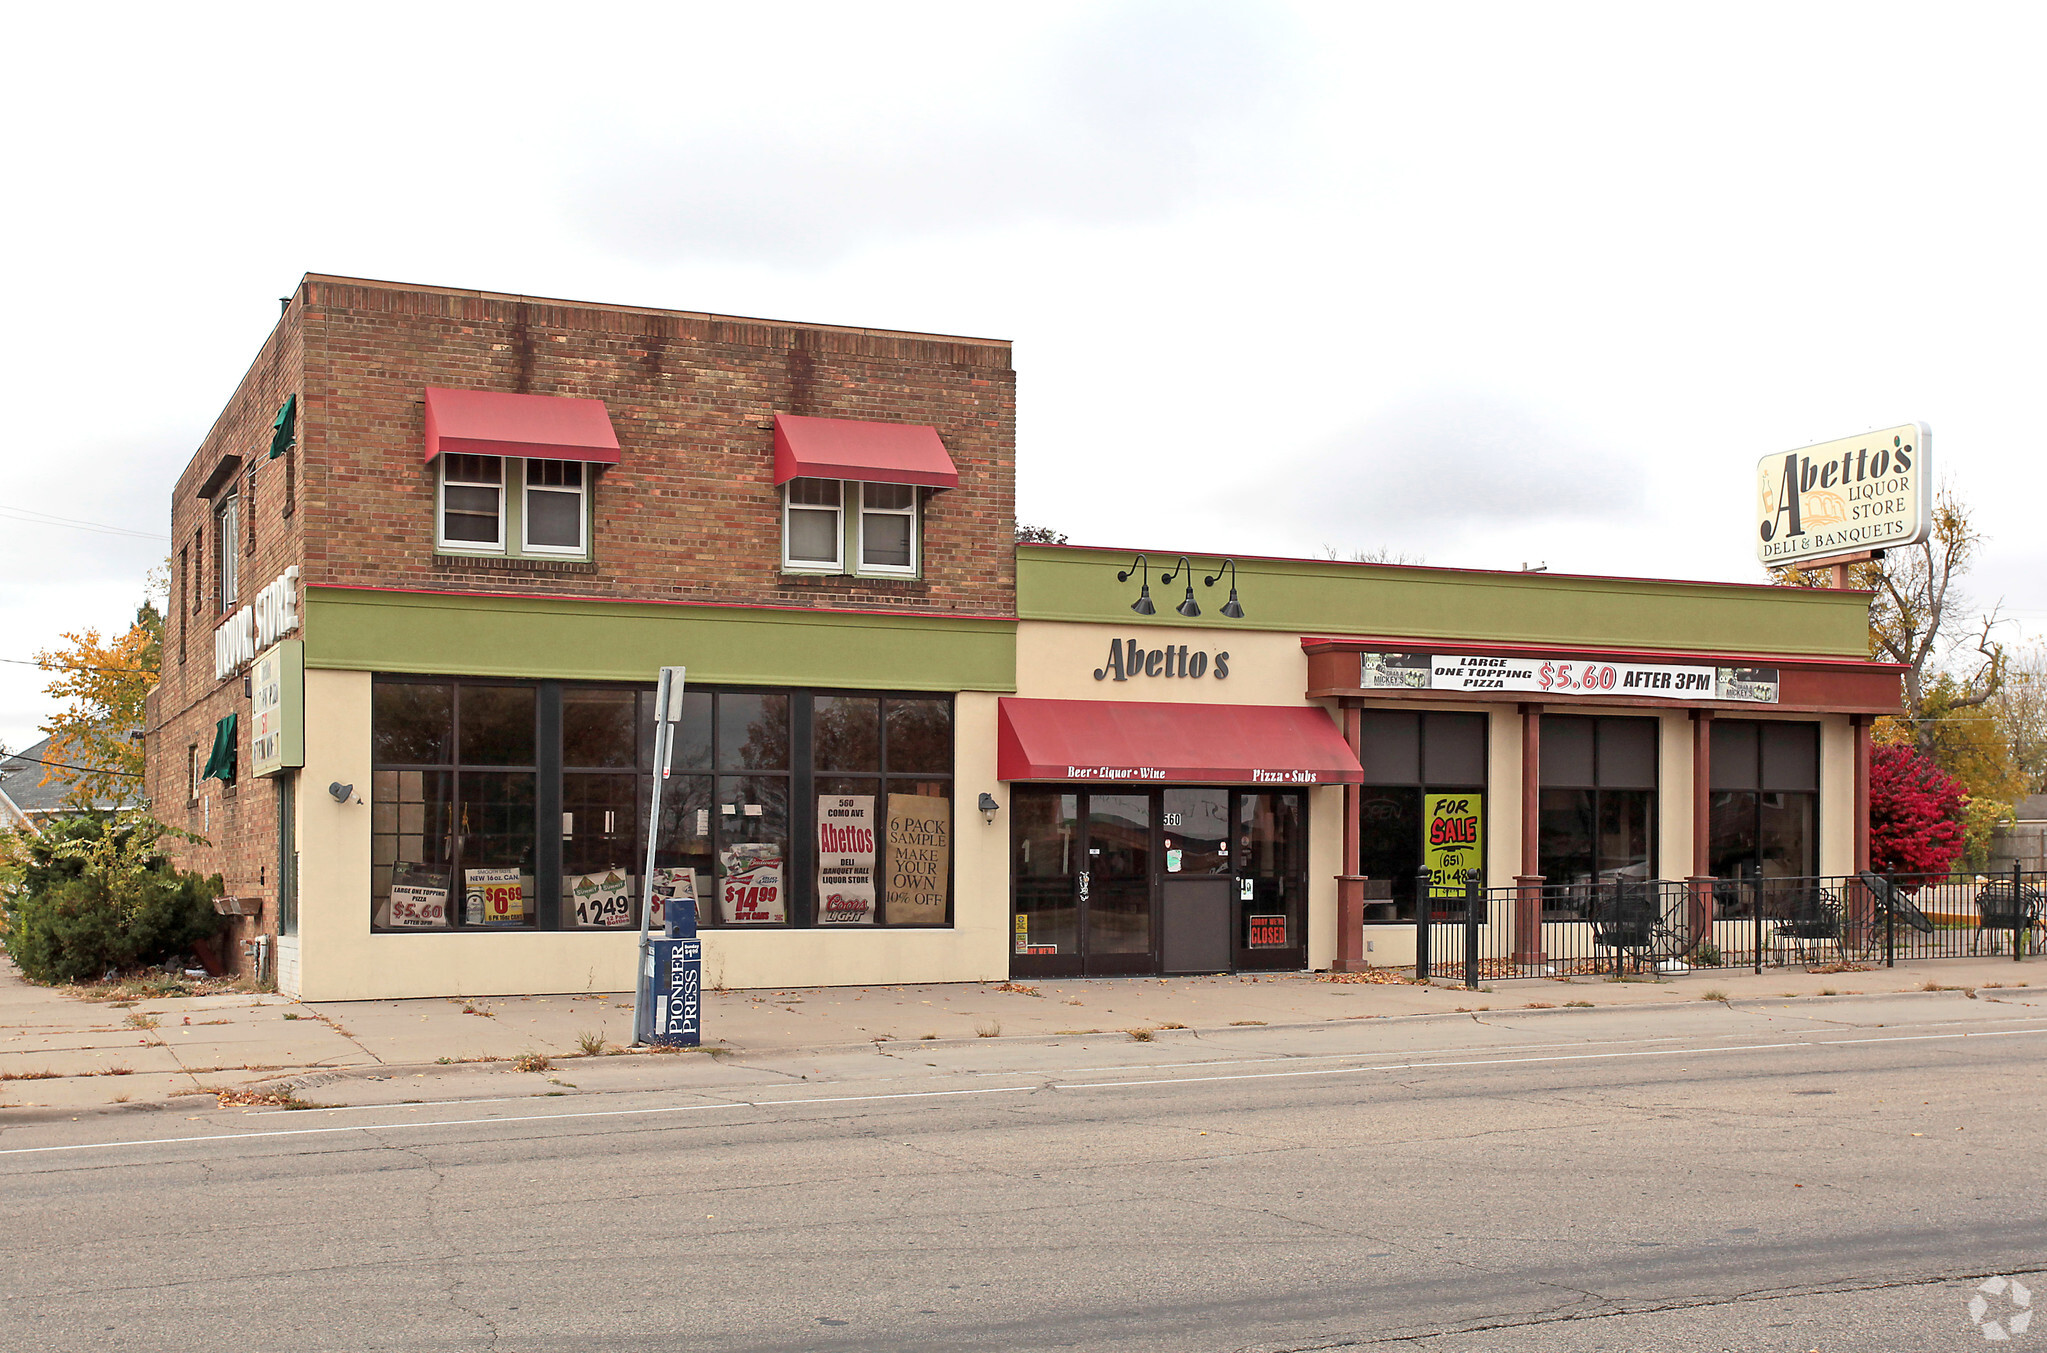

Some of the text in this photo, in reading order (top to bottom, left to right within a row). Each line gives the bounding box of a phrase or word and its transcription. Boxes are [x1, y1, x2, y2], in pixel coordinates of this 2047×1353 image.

[1848, 476, 1910, 502] LIQUOR
[1852, 497, 1906, 520] STORE
[1764, 520, 1903, 557] DELI & BANQUETS
[215, 565, 298, 680] LIQUOR STORE
[1460, 657, 1508, 668] LARGE
[1434, 667, 1533, 679] ONE TOPPING
[1537, 660, 1617, 692] $5.60
[1622, 671, 1671, 689] AFTER
[1674, 672, 1711, 691] 3PM
[1463, 679, 1504, 688] PIZZA
[1067, 766, 1166, 780] Beer Liquor Wine
[1252, 769, 1317, 783] Pizza Subs
[838, 799, 854, 808] 560
[1433, 799, 1469, 816] FOR
[827, 809, 864, 818] COMO AVE
[1163, 813, 1181, 825] 560
[890, 816, 946, 835] 6 PACK
[1429, 816, 1478, 846] SALE
[821, 822, 874, 854] Abettos
[890, 831, 947, 847] SAMPLE
[840, 858, 855, 866] DELI
[895, 847, 939, 862] MAKE
[1440, 852, 1464, 868] (651)
[822, 867, 870, 875] BANQUET HALL
[895, 860, 938, 875] YOUR
[822, 876, 869, 885] LIQUOR STORE
[893, 874, 937, 891] OWN
[423, 889, 446, 897] TOPPING
[886, 891, 943, 906] 10% OFF
[392, 901, 443, 919] $5.60
[825, 893, 869, 912] Coors
[825, 911, 865, 922] LIGHT
[1251, 927, 1285, 944] CLOSED
[669, 945, 684, 1034] PIONEER
[683, 969, 698, 1034] PRESS
